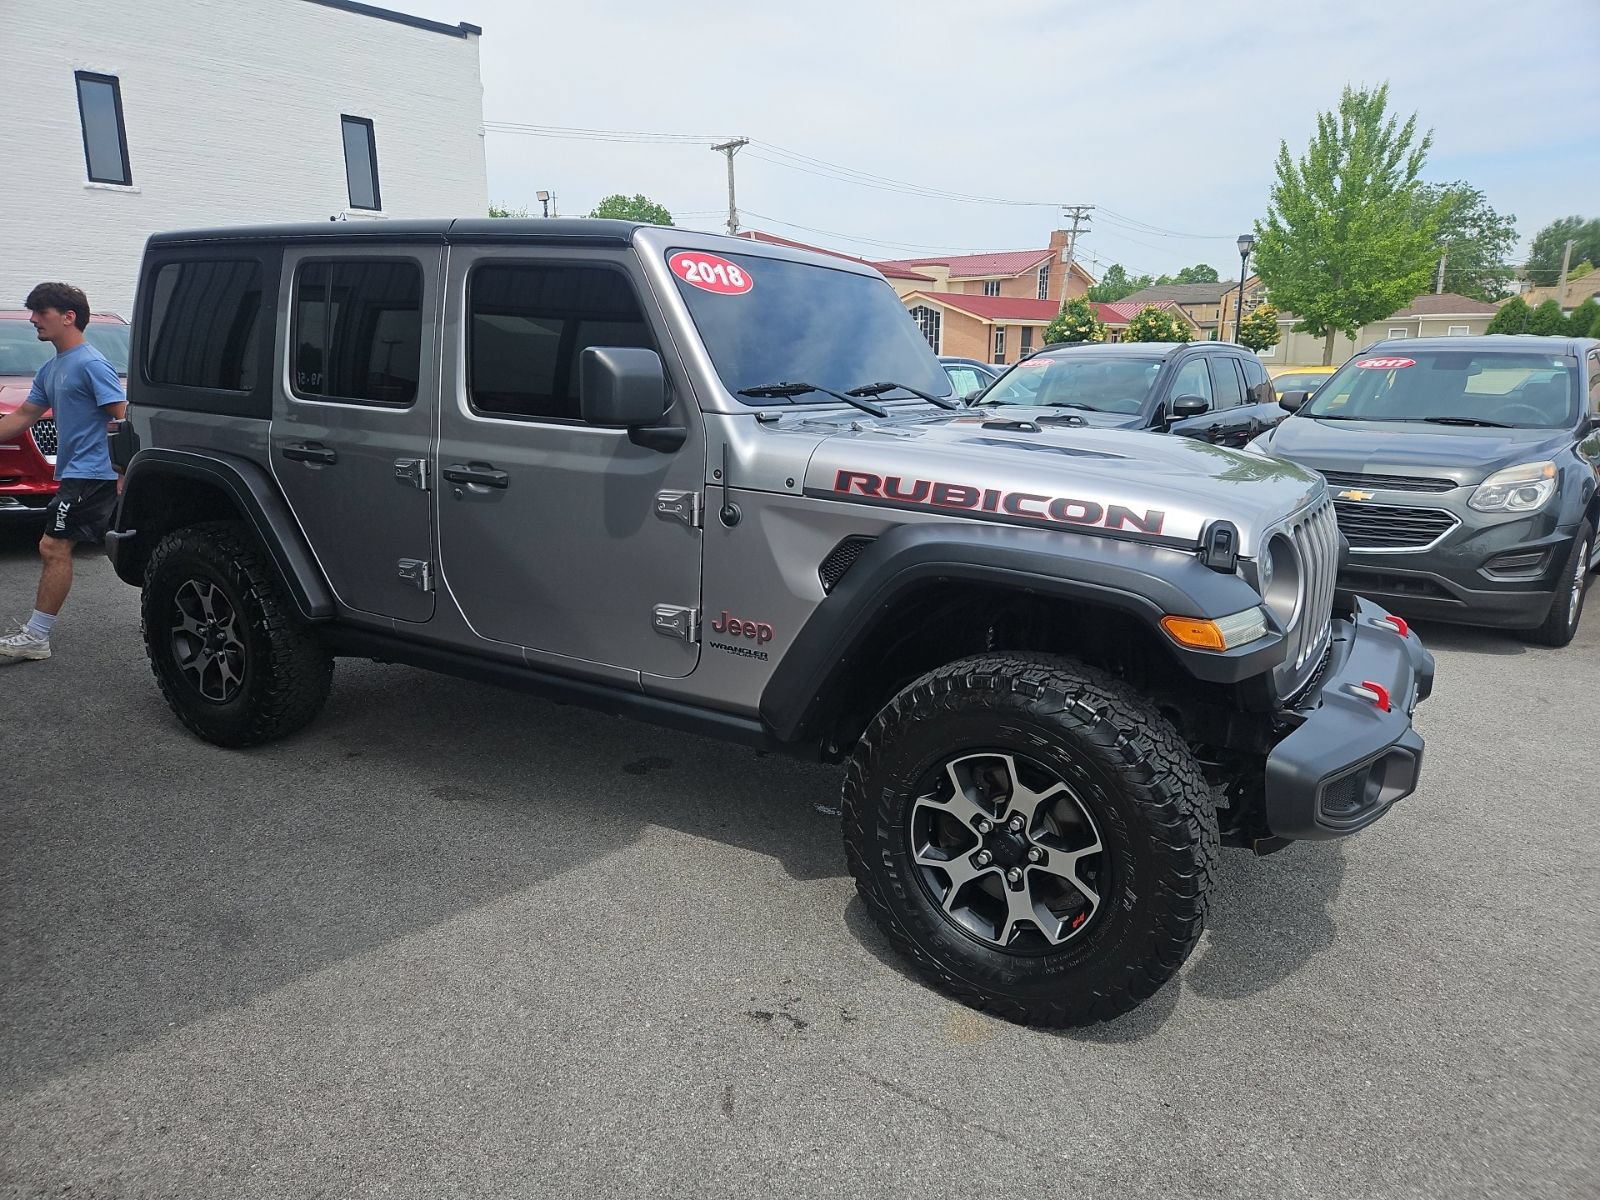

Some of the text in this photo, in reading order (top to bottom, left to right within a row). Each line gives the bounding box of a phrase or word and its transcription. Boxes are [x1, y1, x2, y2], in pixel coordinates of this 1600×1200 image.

[681, 259, 745, 288] 2018
[1361, 359, 1411, 368] 2017
[833, 468, 1165, 535] RUBICON
[711, 610, 774, 645] Jeep
[709, 640, 769, 659] WRANGLER
